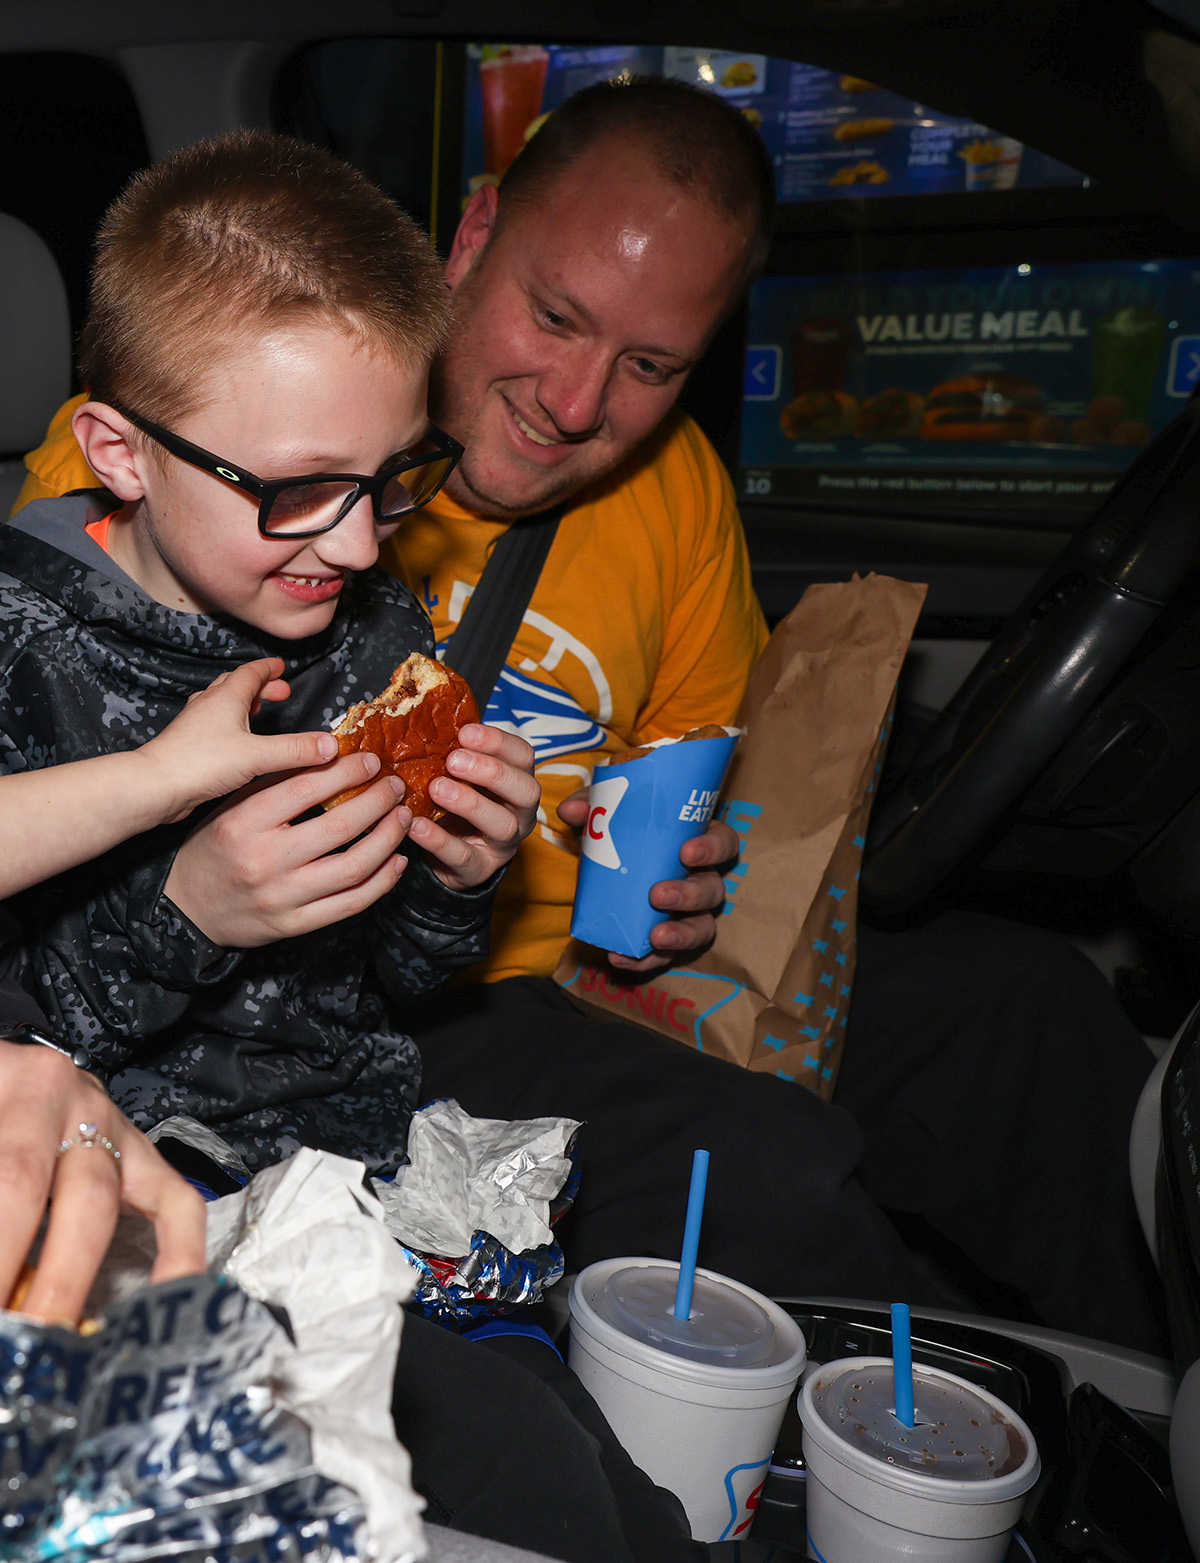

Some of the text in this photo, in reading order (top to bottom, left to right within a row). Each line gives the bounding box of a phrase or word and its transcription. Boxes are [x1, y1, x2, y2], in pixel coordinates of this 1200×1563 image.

[856, 309, 1089, 343] VALUE MEAL
[744, 477, 773, 496] 10
[818, 474, 855, 490] Press
[857, 475, 881, 490] the
[881, 476, 904, 491] red
[906, 476, 953, 492] button
[955, 478, 997, 493] below
[999, 479, 1016, 493] to
[1017, 479, 1054, 493] start
[1055, 480, 1089, 495] your
[579, 967, 697, 1032] SONIC
